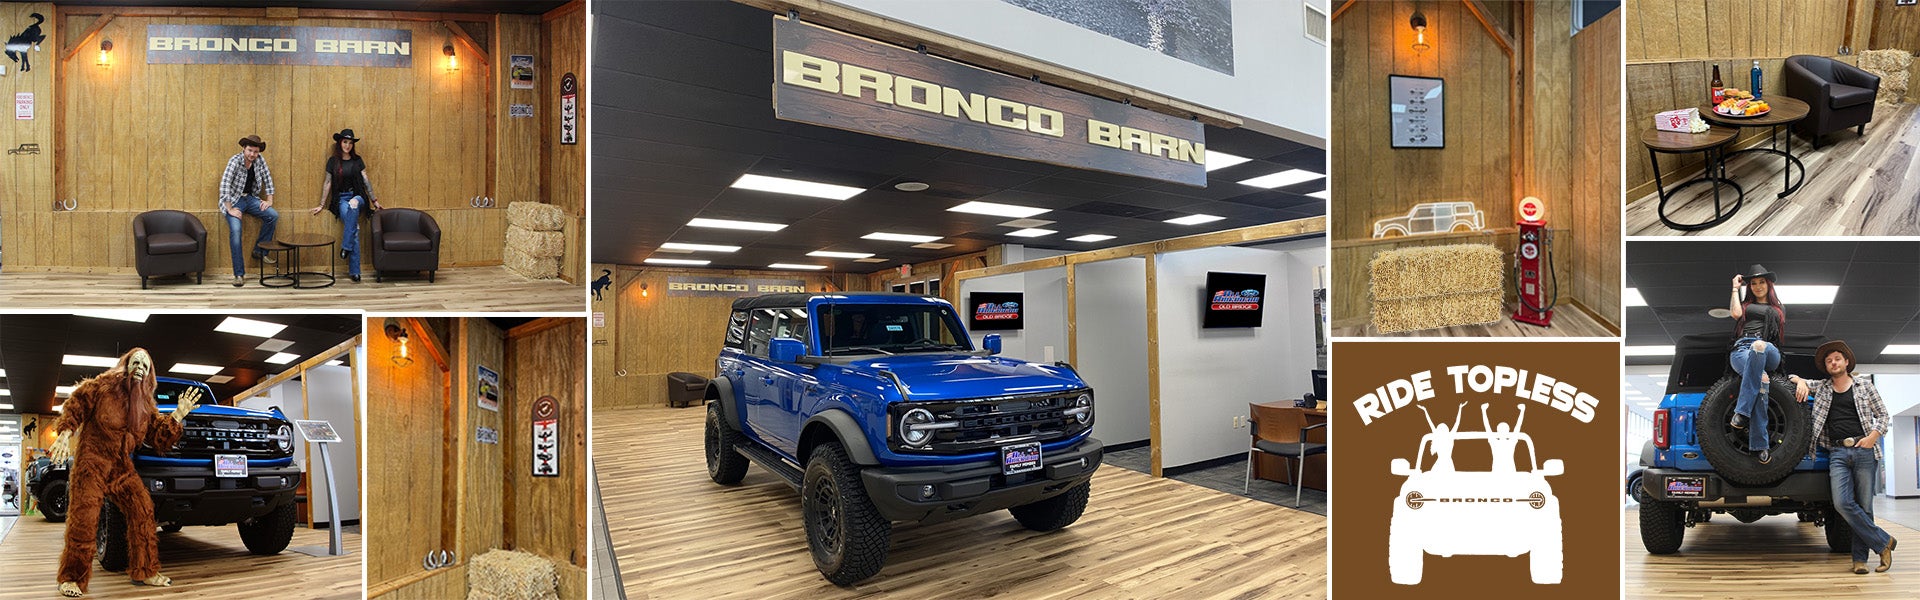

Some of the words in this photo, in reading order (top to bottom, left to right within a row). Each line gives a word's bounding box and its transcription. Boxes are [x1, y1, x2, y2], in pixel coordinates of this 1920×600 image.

[149, 37, 297, 52] BRONCO
[315, 39, 410, 56] BARN
[511, 106, 532, 115] BRONCO
[782, 50, 1065, 138] BRONCO
[1087, 118, 1205, 165] BARN
[669, 282, 748, 292] BRONCO
[757, 285, 805, 293] BARN
[1353, 370, 1435, 426] RIDE
[1447, 365, 1599, 424] TOPLESS
[963, 411, 1061, 427] BRONCO
[186, 430, 265, 438] BRONCO
